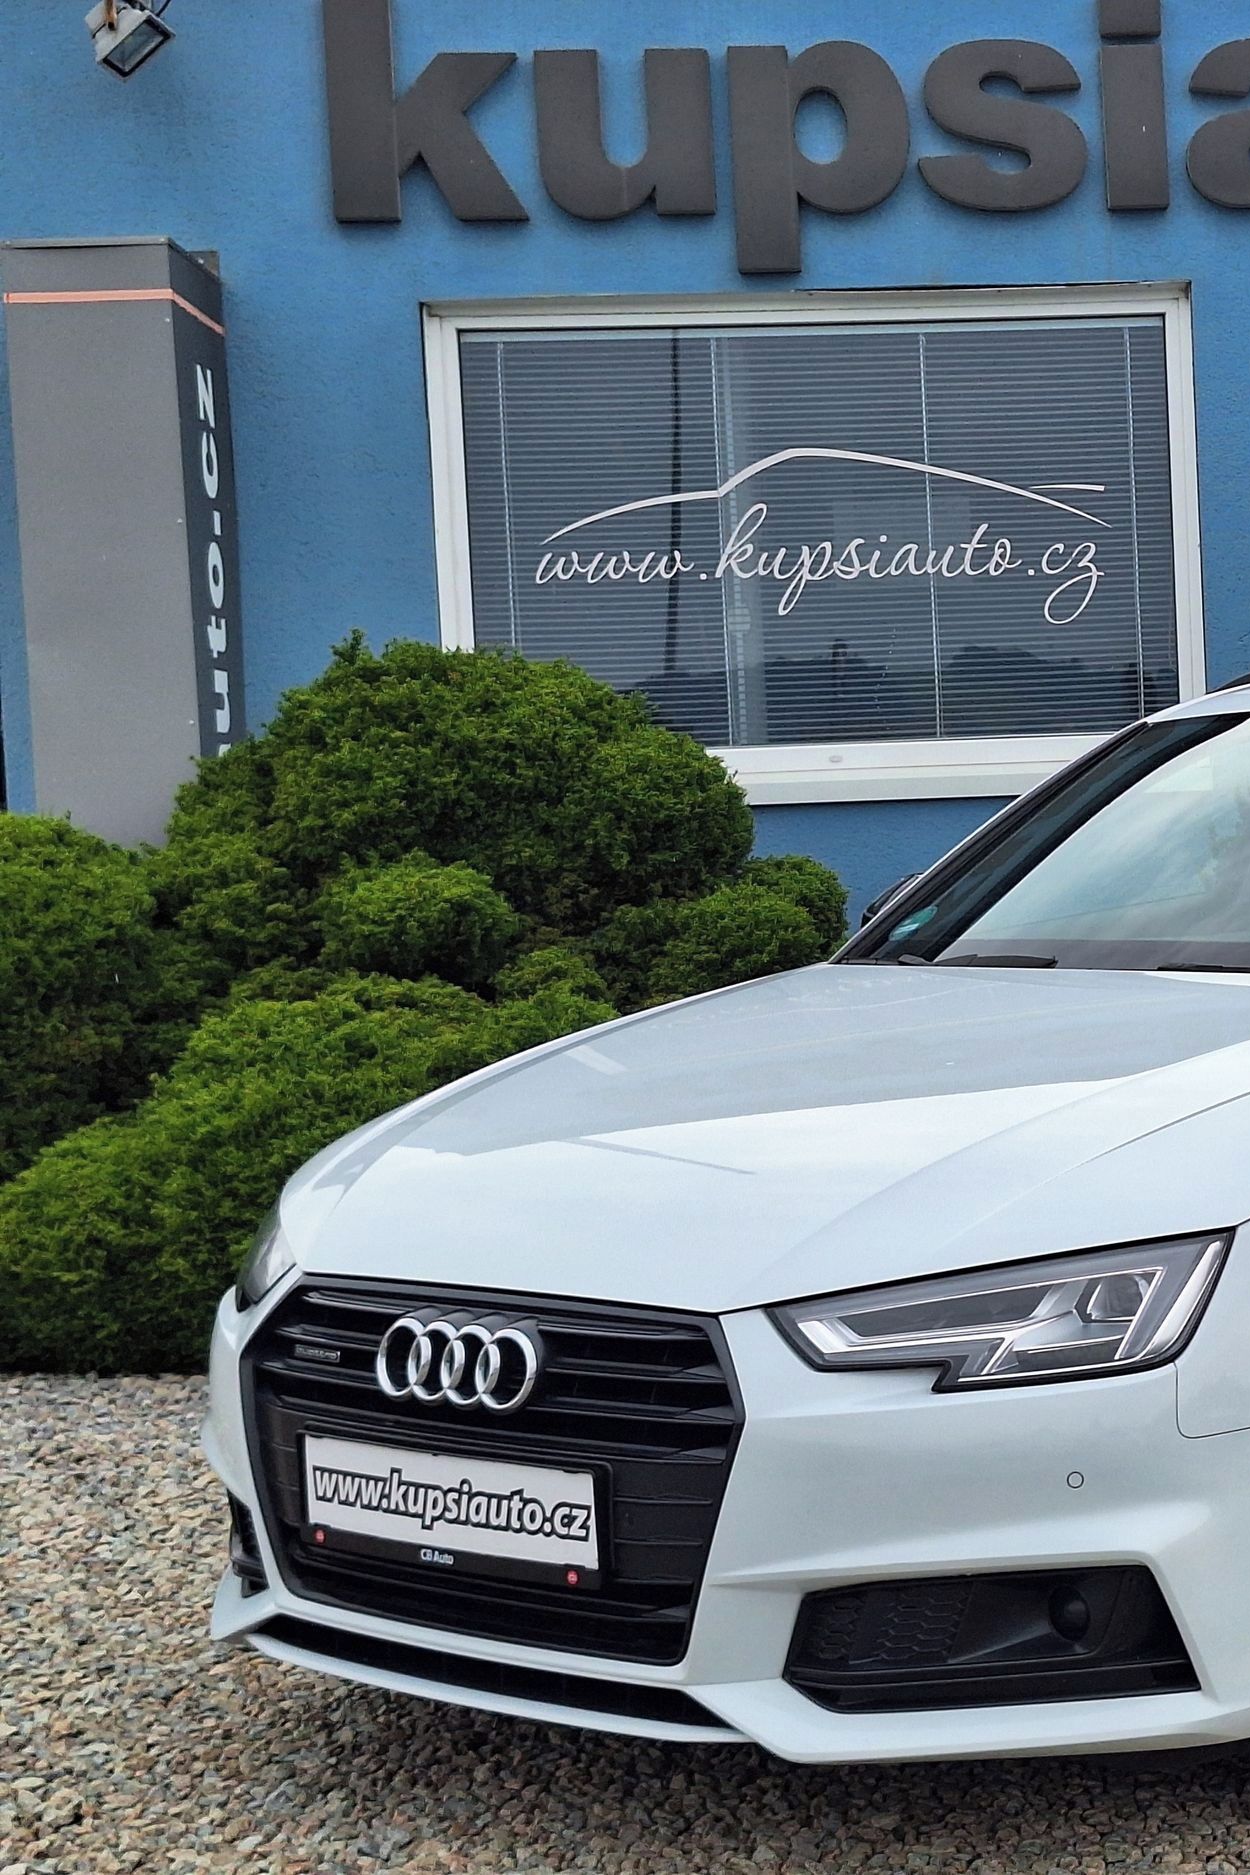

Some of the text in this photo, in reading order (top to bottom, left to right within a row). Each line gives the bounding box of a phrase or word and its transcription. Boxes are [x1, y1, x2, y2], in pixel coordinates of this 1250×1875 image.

[196, 363, 232, 758] uto.cz
[535, 503, 1105, 625] www.kupsiauto.cz
[313, 1466, 590, 1541] www.kupsiauto.cz
